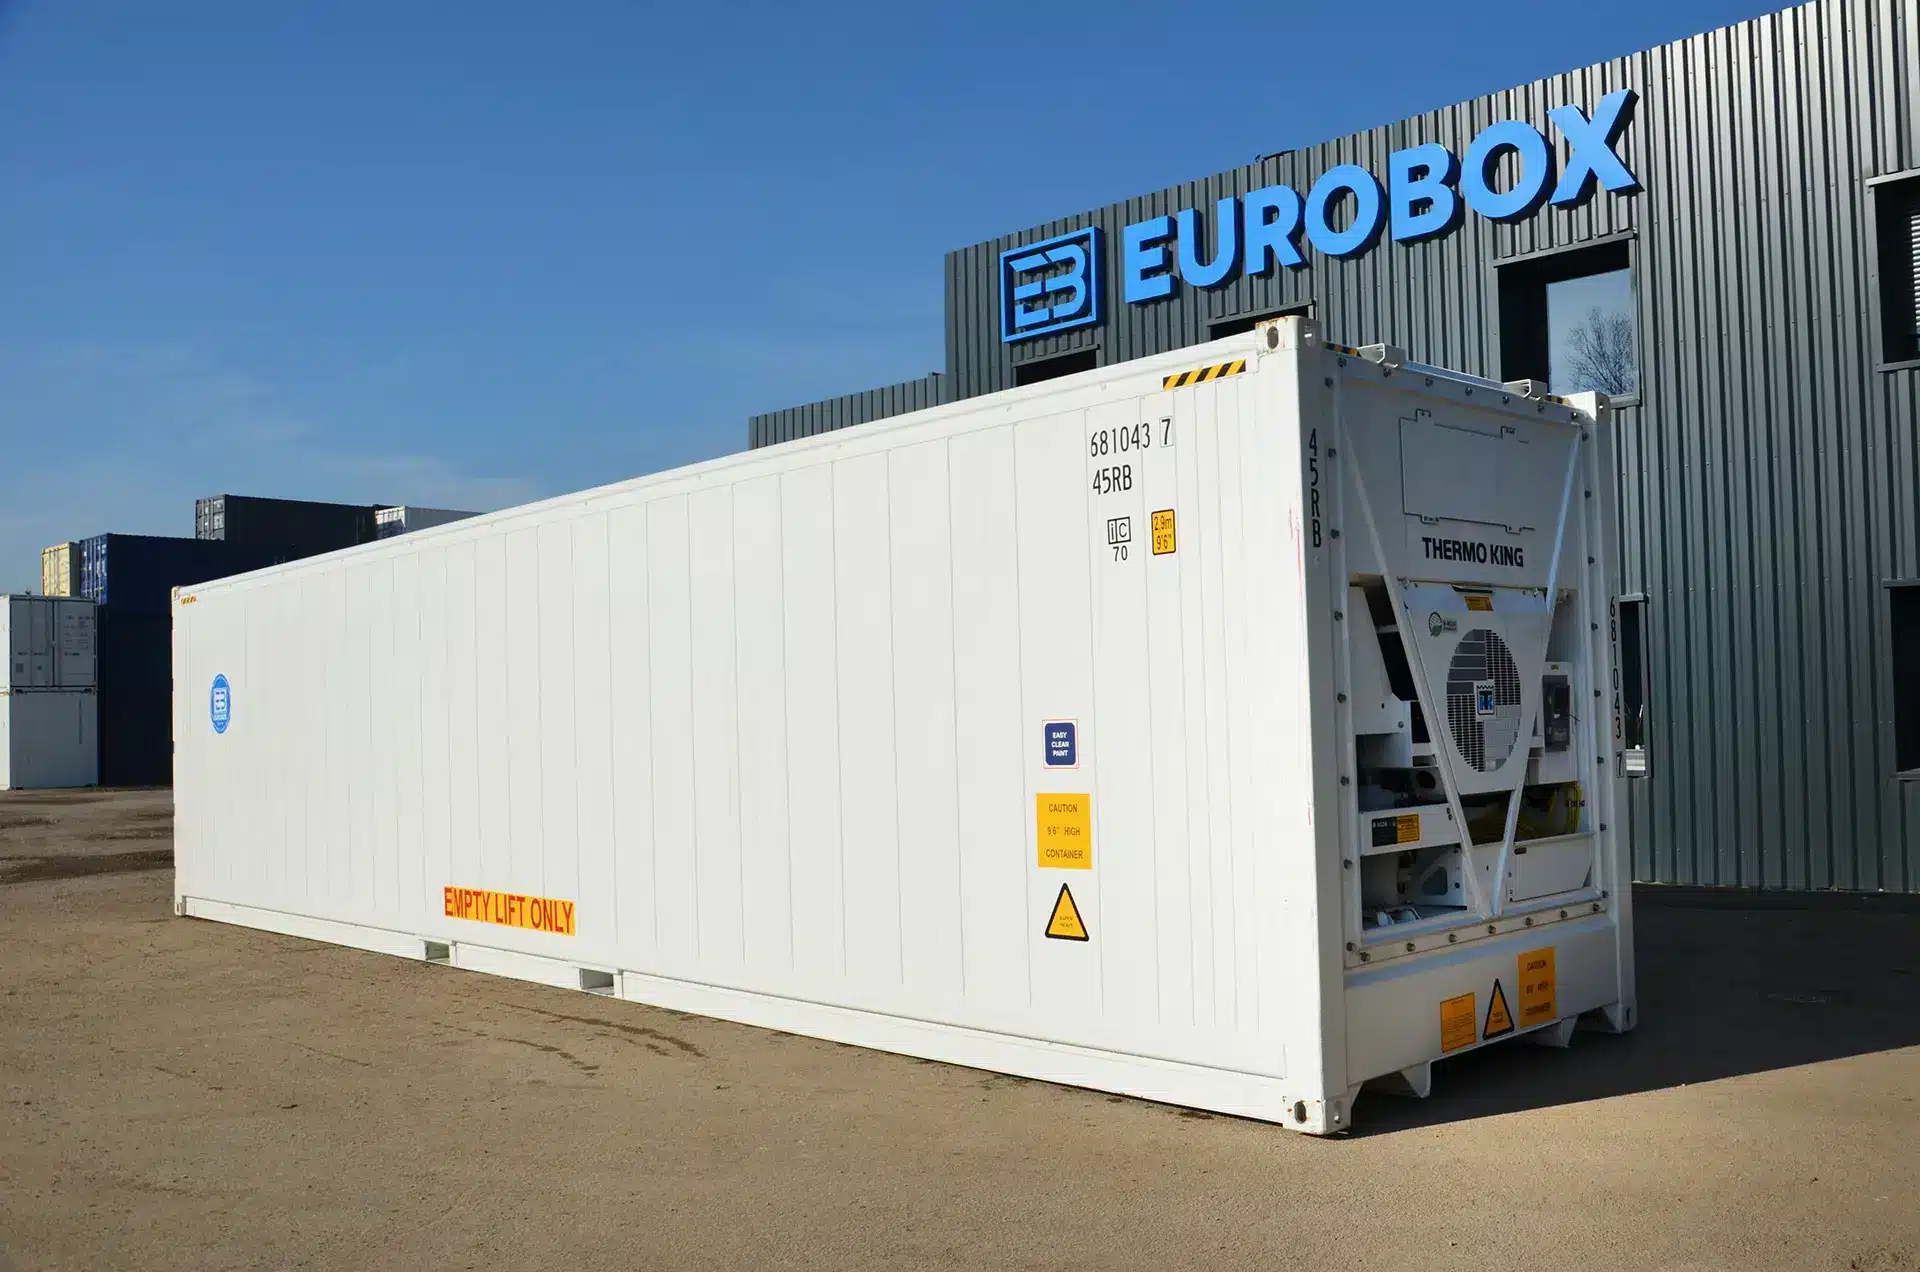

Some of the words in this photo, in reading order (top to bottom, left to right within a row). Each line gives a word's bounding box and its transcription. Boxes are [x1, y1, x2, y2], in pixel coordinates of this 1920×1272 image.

[1124, 88, 1640, 303] EUROBOX
[1090, 422, 1151, 457] 681043
[1160, 417, 1172, 446] 7
[1092, 464, 1133, 495] 45RB
[1309, 428, 1322, 548] 45RB
[1112, 545, 1128, 562] 70
[1421, 536, 1487, 564] THERMO
[1490, 544, 1524, 567] KING
[1609, 595, 1621, 740] 681043
[1051, 740, 1070, 748] CLEAN
[1052, 731, 1068, 739] EASY
[1052, 749, 1069, 757] PAINT
[1048, 803, 1078, 813] CAUTION
[1064, 825, 1081, 836] HIGH
[1045, 848, 1084, 860] CONTAINER
[443, 886, 491, 921] EMPTY
[495, 893, 525, 926] LIFT
[530, 898, 574, 934] ONLY
